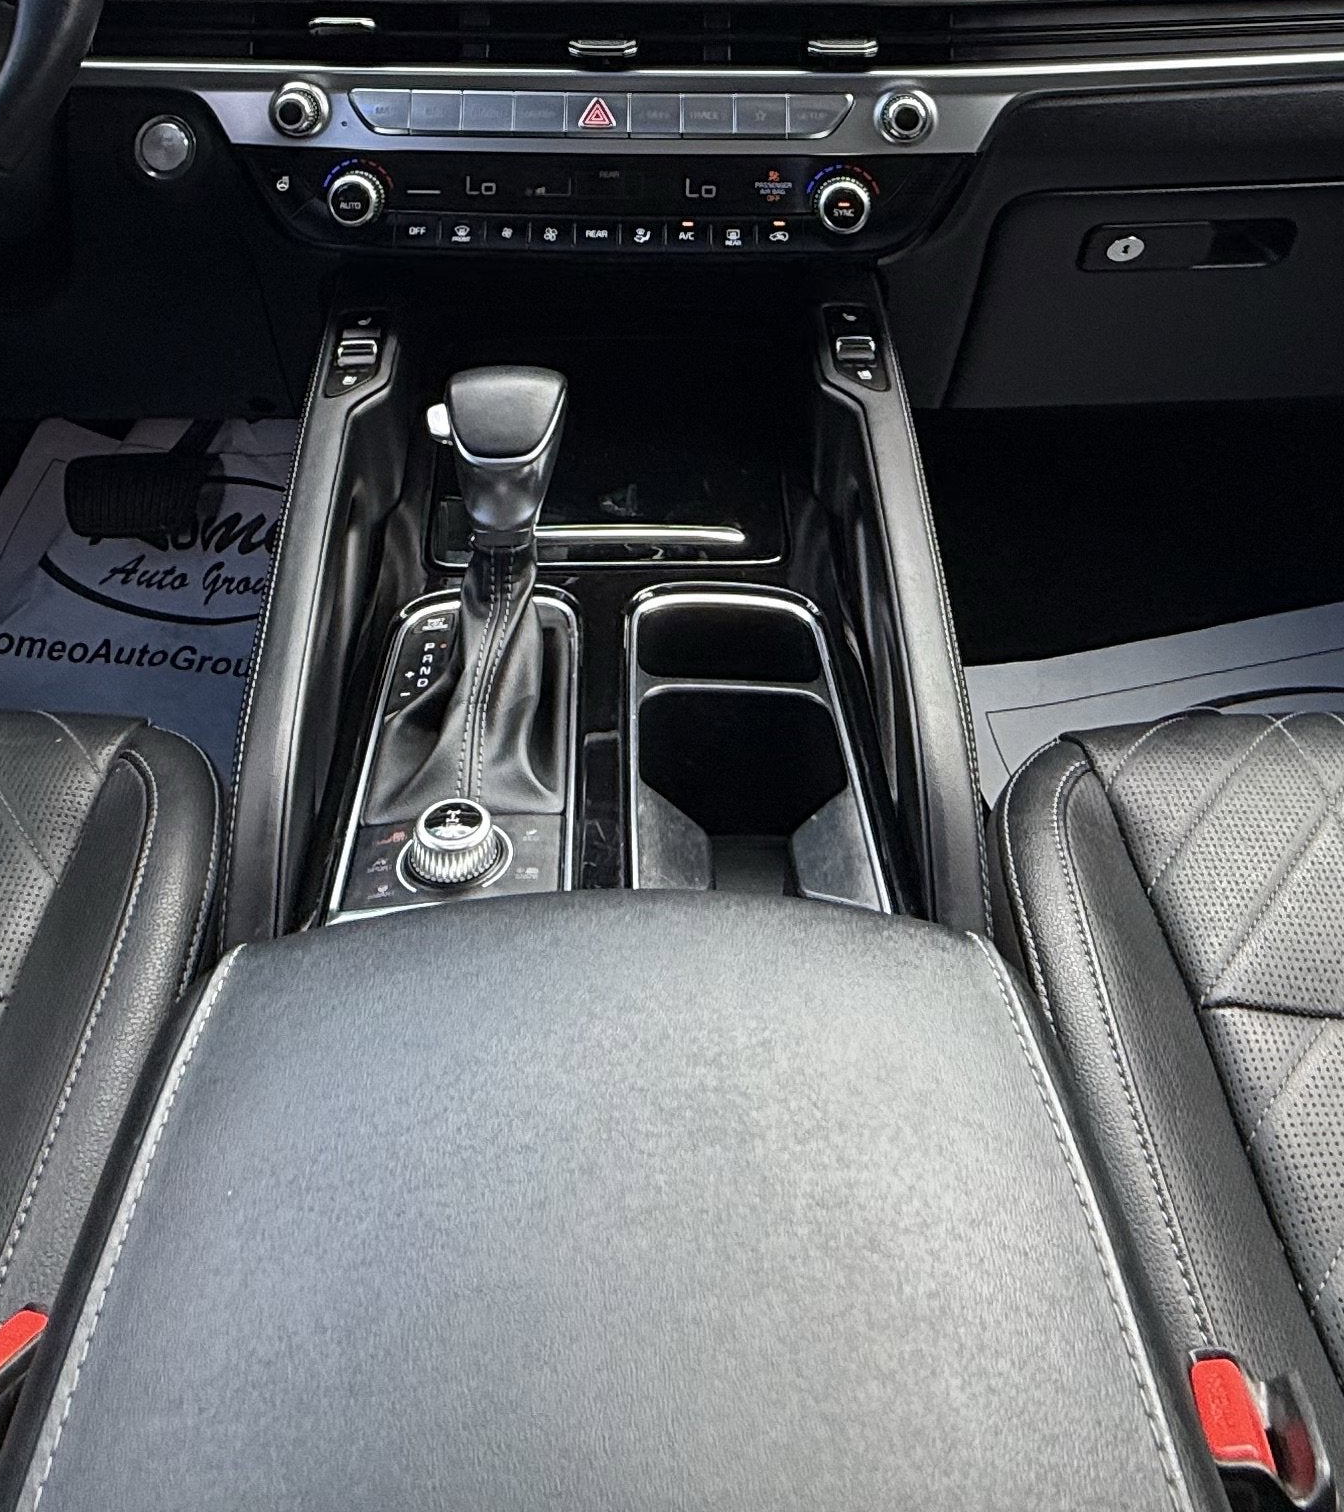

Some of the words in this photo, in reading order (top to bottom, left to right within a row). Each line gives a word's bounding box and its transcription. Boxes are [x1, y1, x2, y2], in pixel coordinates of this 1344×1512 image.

[466, 176, 496, 195] Lo
[686, 178, 716, 198] Lo
[339, 201, 361, 210] AUTO
[833, 208, 854, 217] SYNC
[409, 226, 426, 236] OFF
[585, 230, 608, 239] REAR
[679, 232, 695, 241] A/C
[98, 554, 189, 590] Auto
[424, 642, 435, 652] P
[419, 666, 431, 675] N
